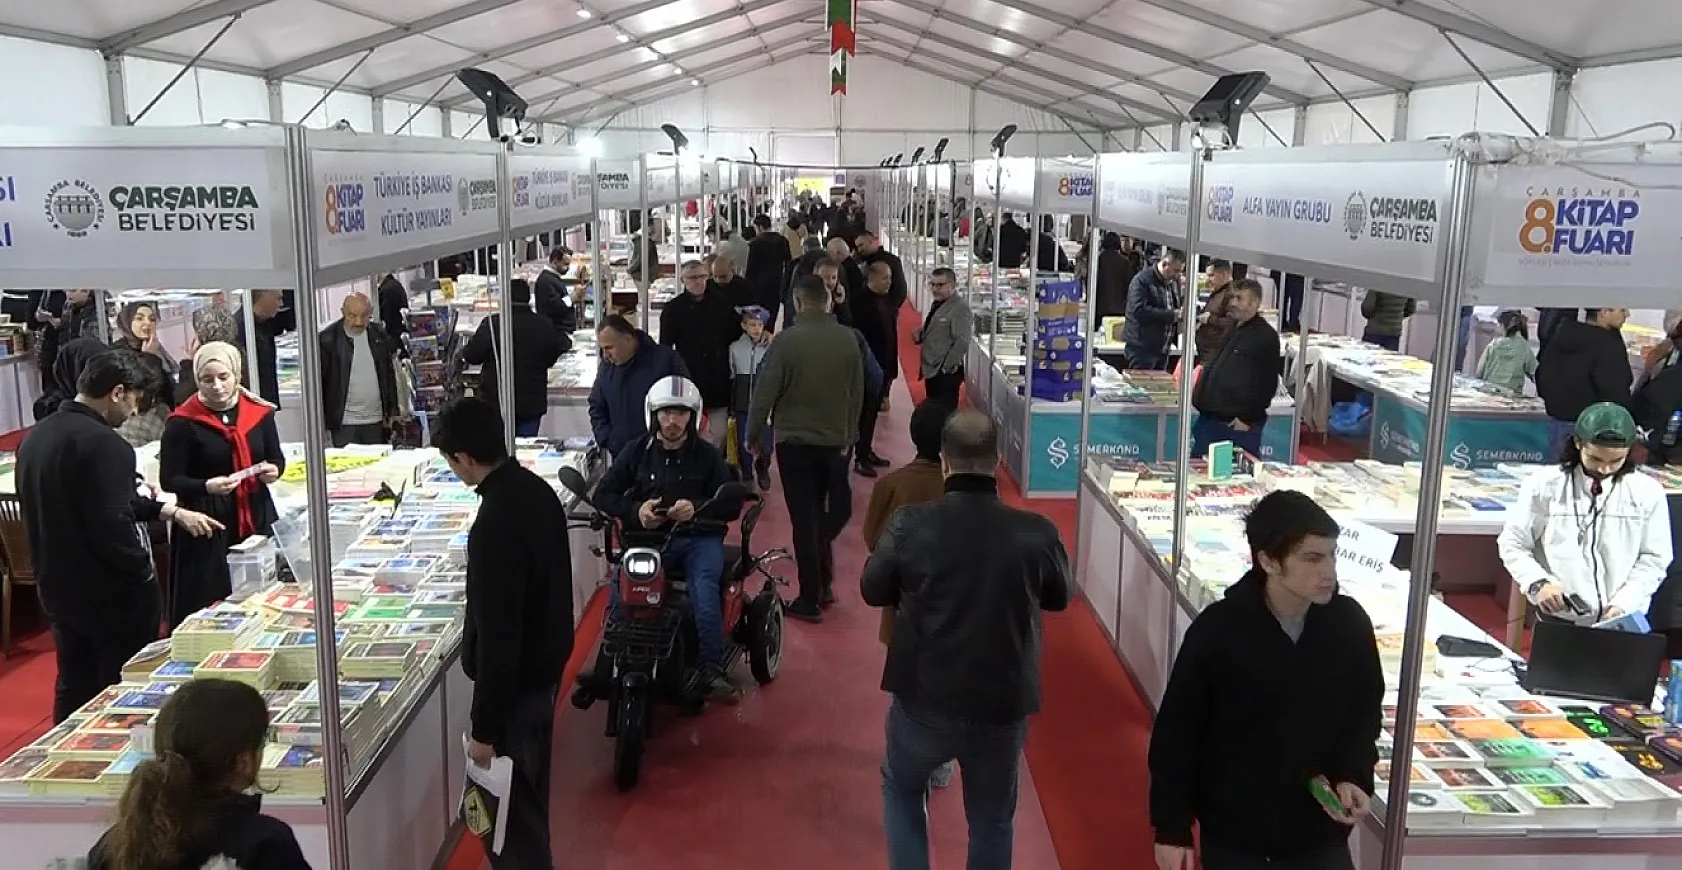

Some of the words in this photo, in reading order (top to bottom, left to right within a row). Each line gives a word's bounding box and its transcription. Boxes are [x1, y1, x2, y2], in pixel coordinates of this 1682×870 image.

[373, 170, 411, 199] TÜRKİYE
[1525, 186, 1641, 198] ÇARŞAMBA
[108, 186, 260, 211] ÇARŞAMBA
[1242, 196, 1263, 215] ALFA
[1265, 198, 1291, 219] YAYIN
[1293, 199, 1332, 223] GRUBU
[1369, 197, 1437, 222] ÇARŞAMBA
[118, 212, 256, 231] BELEDİYESİ
[381, 207, 415, 237] KÜLTÜR
[1556, 198, 1640, 227] KİTAP
[1370, 221, 1434, 243] BELEDİYESİ
[1553, 228, 1635, 255] FUARI
[1073, 443, 1140, 455] SMERKAND
